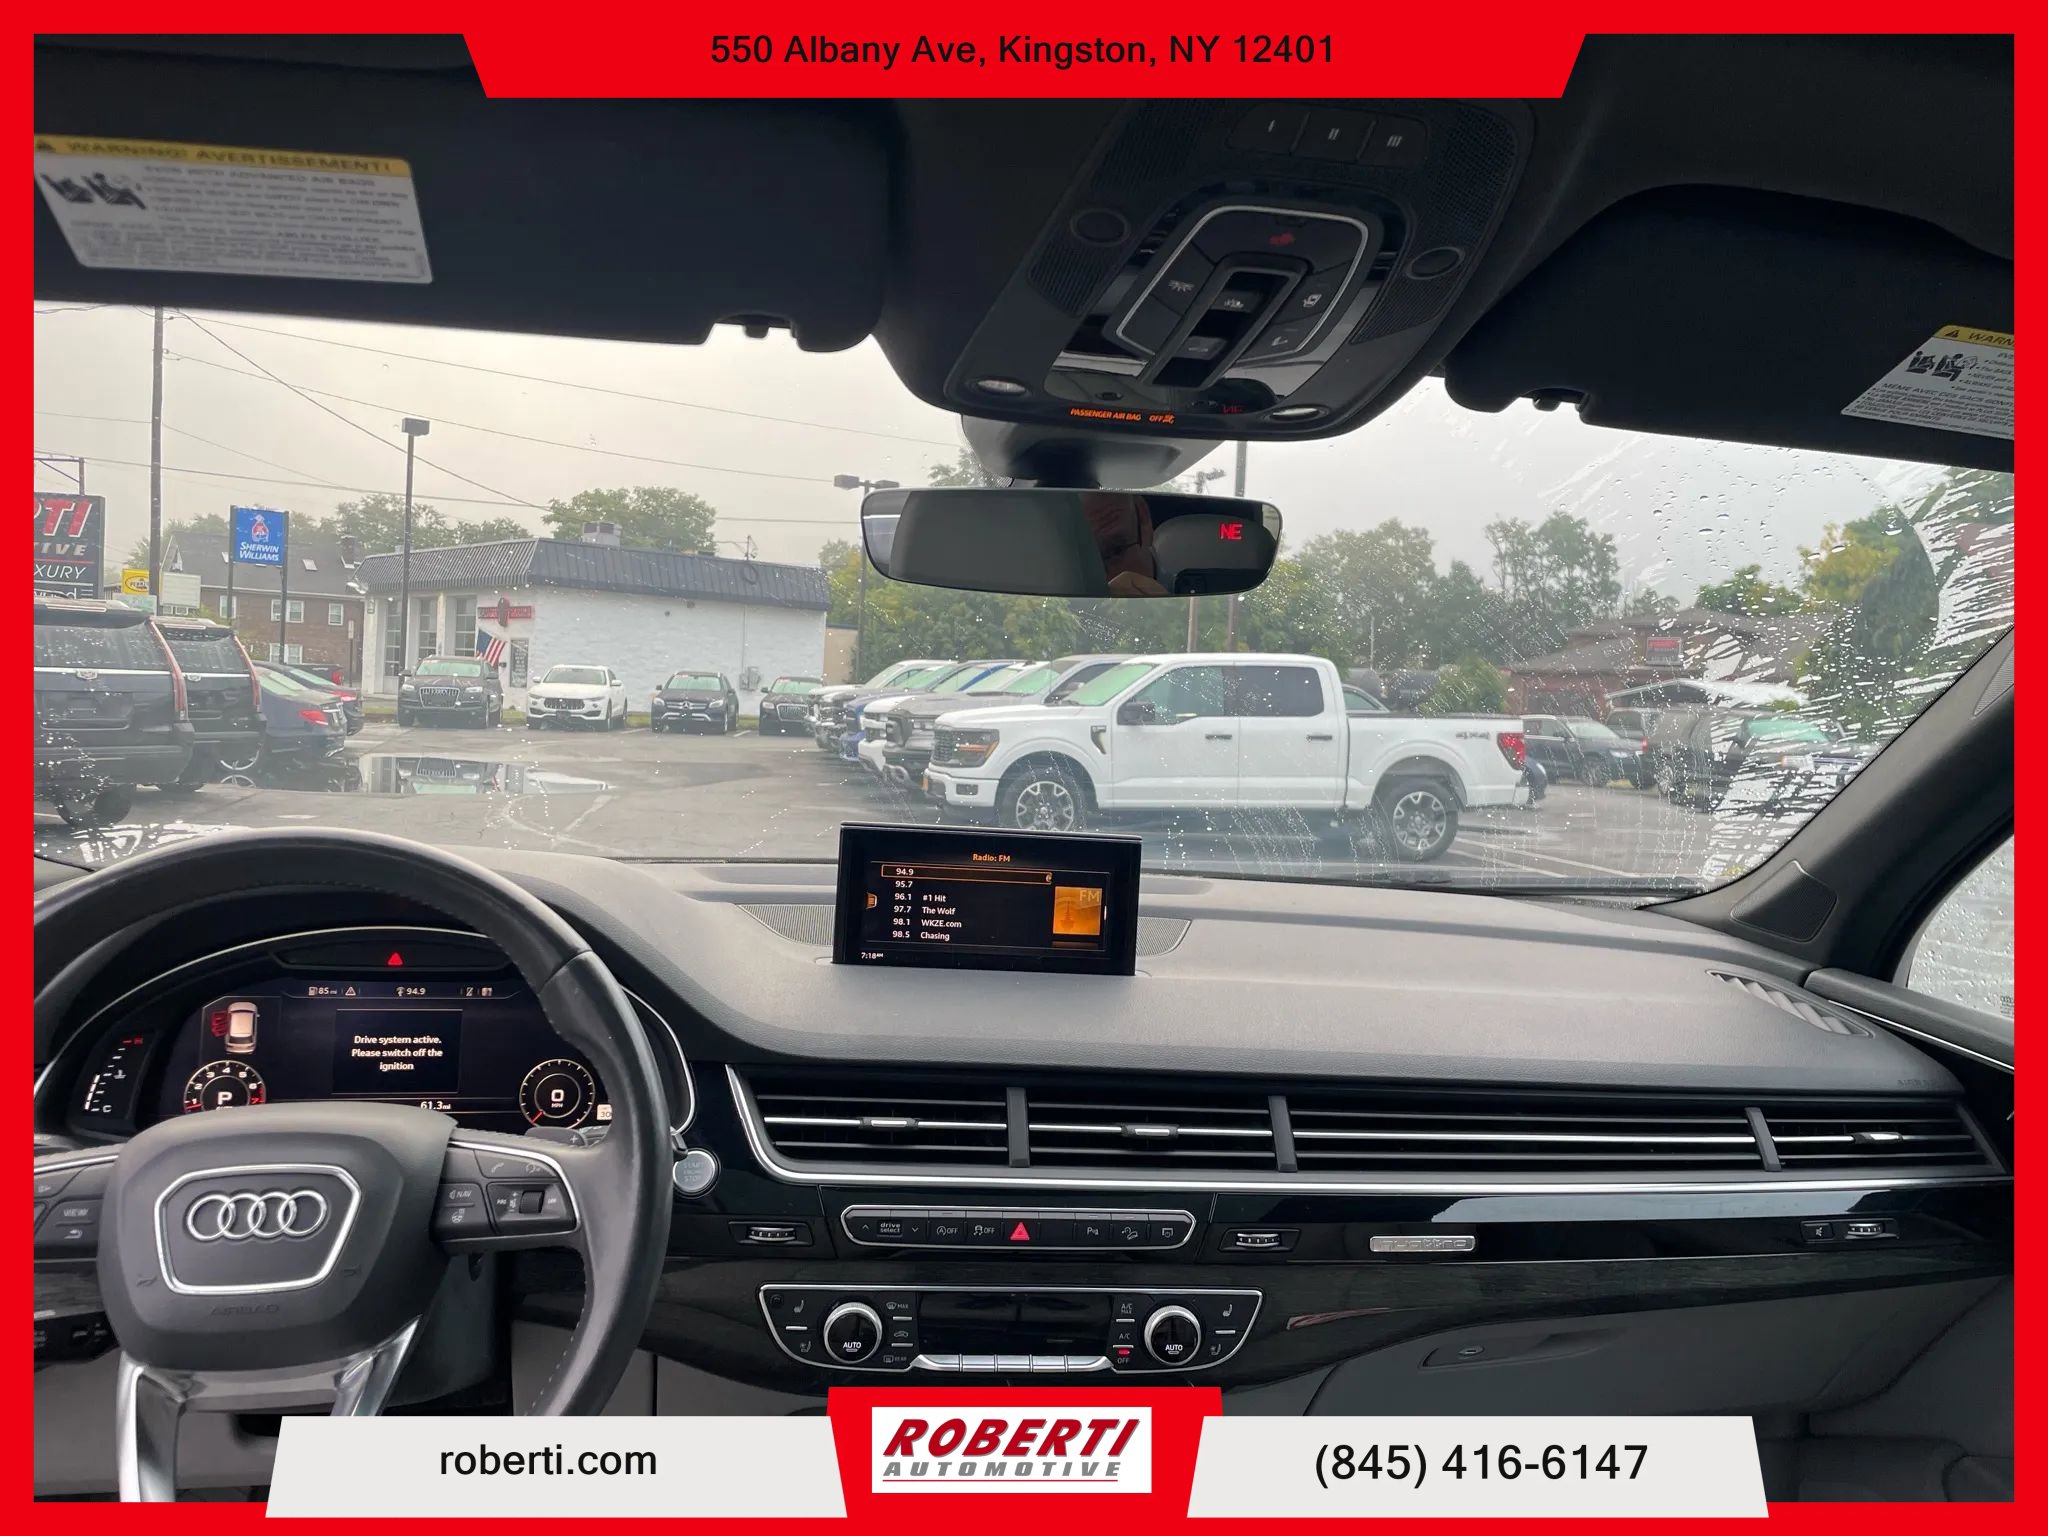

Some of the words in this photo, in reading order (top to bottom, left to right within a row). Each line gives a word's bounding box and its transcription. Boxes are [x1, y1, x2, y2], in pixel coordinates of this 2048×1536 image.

[1070, 408, 1112, 419] PASSENGER
[1113, 411, 1125, 420] AIR
[1126, 413, 1142, 422] BAG
[1149, 414, 1163, 423] OFF
[1219, 523, 1243, 540] NE
[239, 541, 280, 553] SHERWIN
[239, 550, 280, 562] WILLIAMS
[972, 853, 997, 863] Radio:
[998, 854, 1011, 863] FM
[896, 867, 914, 876] 94.9
[895, 880, 913, 888] 95.7
[894, 893, 912, 901] 96.1
[923, 894, 932, 902] #1
[934, 895, 947, 903] Hit
[1079, 889, 1100, 902] FM
[893, 905, 912, 913] 97.7
[922, 906, 936, 914] The
[937, 907, 956, 916] Wolf
[893, 918, 910, 926] 98.1
[921, 919, 962, 928] WKZE.com
[892, 930, 910, 938] 98.5
[920, 931, 950, 942] Chasing
[318, 987, 329, 995] 85
[406, 987, 426, 995] 94.9
[354, 1035, 378, 1045] Drive
[379, 1036, 412, 1047] system
[412, 1035, 442, 1045] active.
[351, 1048, 381, 1058] Please
[382, 1048, 412, 1058] switch
[412, 1048, 427, 1058] off
[427, 1048, 444, 1058] the
[379, 1061, 415, 1072] ignition
[217, 1091, 233, 1105] P
[551, 1088, 565, 1102] 0
[102, 1104, 112, 1113] C
[456, 1190, 473, 1198] NAV
[843, 1341, 862, 1349] AUTO
[1165, 1344, 1183, 1352] AUTO
[1117, 1357, 1130, 1365] OFF
